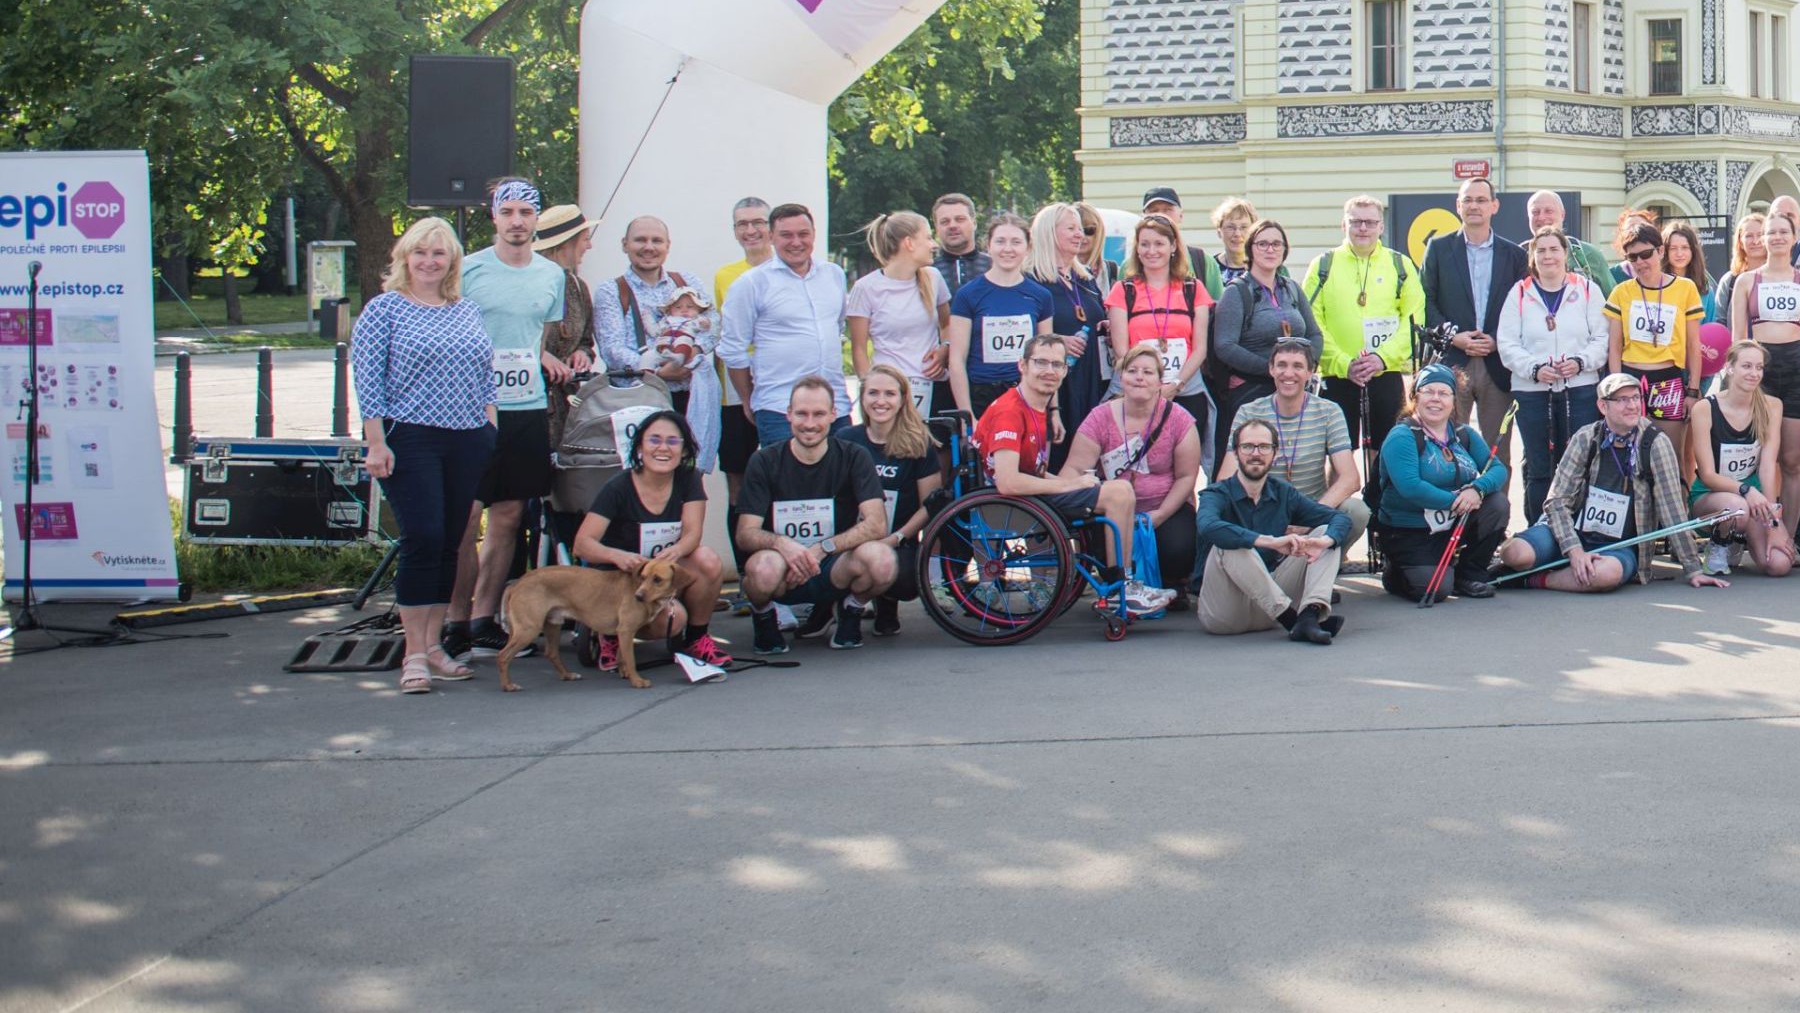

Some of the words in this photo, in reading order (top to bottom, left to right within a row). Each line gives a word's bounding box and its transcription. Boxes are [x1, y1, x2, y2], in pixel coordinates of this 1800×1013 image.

[0, 182, 67, 240] epi
[75, 203, 120, 218] STOP
[0, 244, 46, 254] POLEČNĚ
[50, 244, 77, 254] PROTI
[81, 244, 126, 254] EPILEPSII
[1766, 296, 1797, 311] 089
[992, 334, 1025, 351] 047
[1163, 356, 1181, 370] 24
[495, 369, 530, 388] 060
[1648, 381, 1682, 415] Lady
[1728, 455, 1756, 472] 052
[1586, 506, 1617, 526] 040
[784, 521, 825, 539] 061
